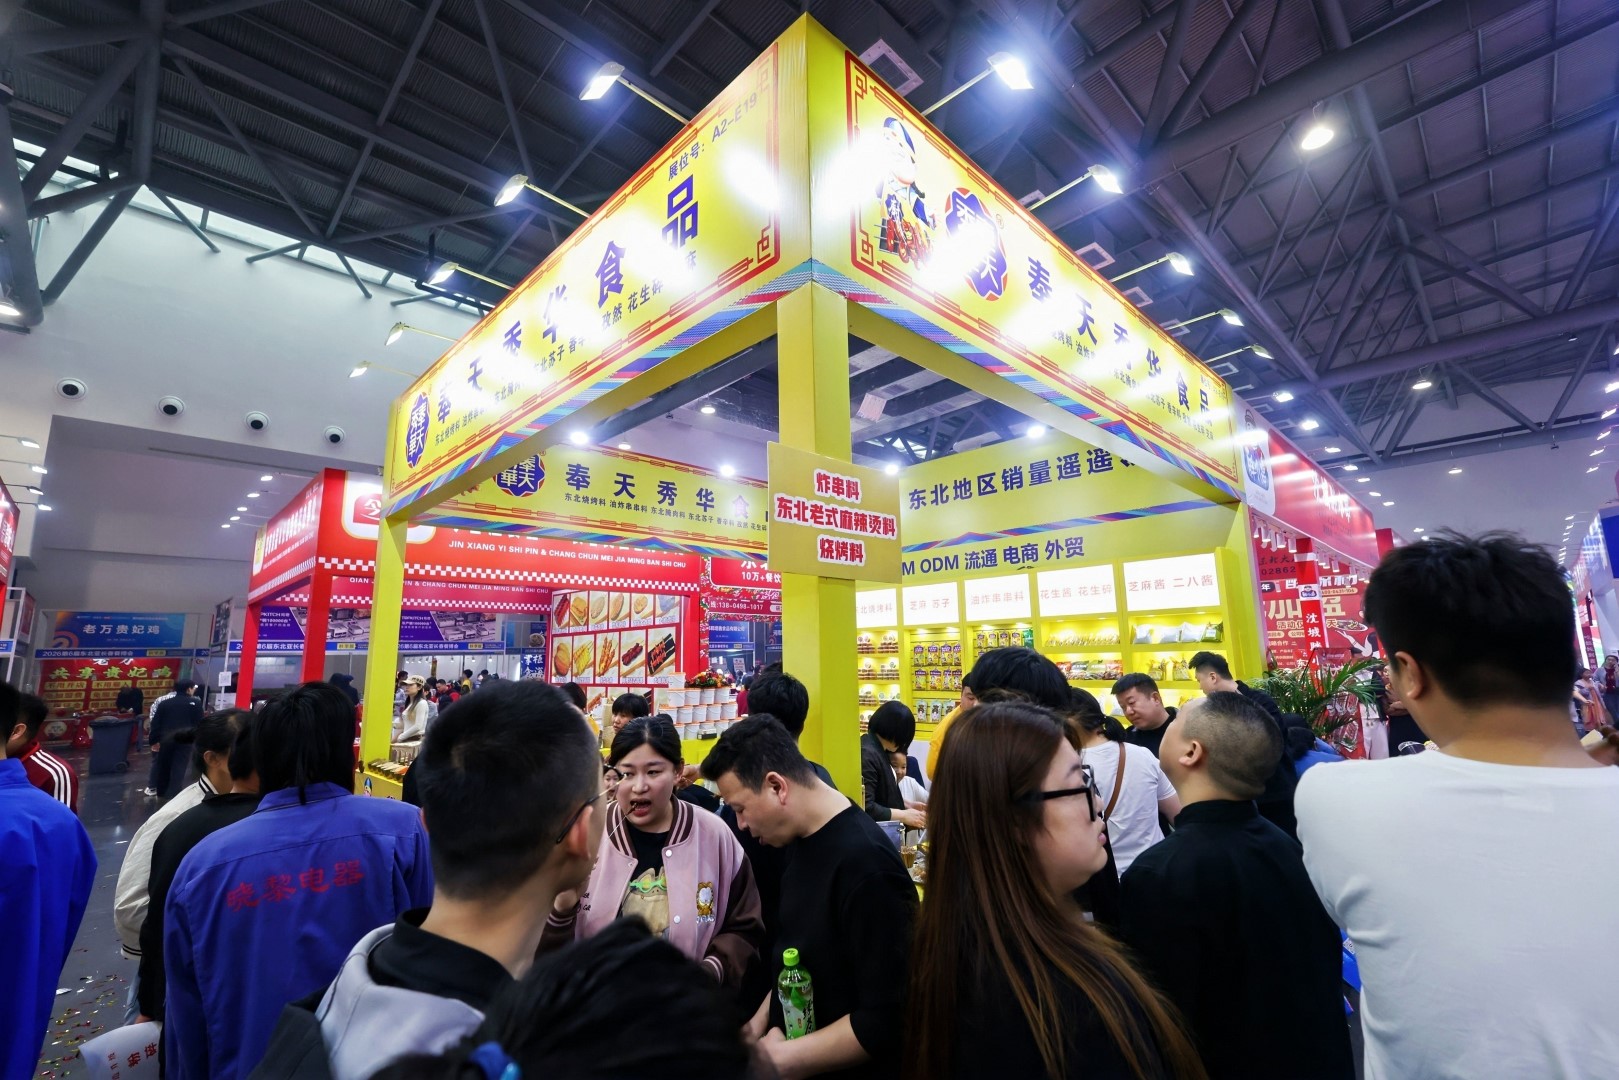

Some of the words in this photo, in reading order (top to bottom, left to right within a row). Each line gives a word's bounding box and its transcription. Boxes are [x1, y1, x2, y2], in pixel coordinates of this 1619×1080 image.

[816, 472, 860, 501] 炸串料
[909, 448, 1137, 510] 东北地区销量遥遥
[565, 492, 606, 507] 东北烧烤料
[609, 500, 648, 513] 油炸串串料
[566, 463, 768, 523] 奉天秀华食
[776, 496, 896, 537] 东北老式麻辣烫料
[449, 540, 464, 548] JIN
[467, 541, 495, 551] XIANG
[498, 544, 507, 552] YI
[509, 545, 523, 554] SHI
[525, 547, 538, 555] PIN
[549, 550, 576, 559] CHANG
[578, 552, 599, 561] CHUN
[601, 554, 614, 562] MEI
[628, 557, 645, 565] MING
[820, 537, 864, 563] 烧烤料
[920, 554, 959, 574] ODM
[964, 548, 998, 571] 流通
[1003, 543, 1039, 564] 电商
[1045, 537, 1085, 561] 外贸
[1040, 587, 1072, 600] 花生酱
[1128, 579, 1166, 592] 芝麻酱
[1173, 574, 1213, 588] 二八酱
[856, 602, 893, 614] 北烧烤料
[910, 600, 927, 611] 芝麻
[971, 591, 1024, 606] 油炸串串料
[83, 624, 160, 635] 老万贵妃鸡
[49, 665, 173, 680] 共享贵妃鸡
